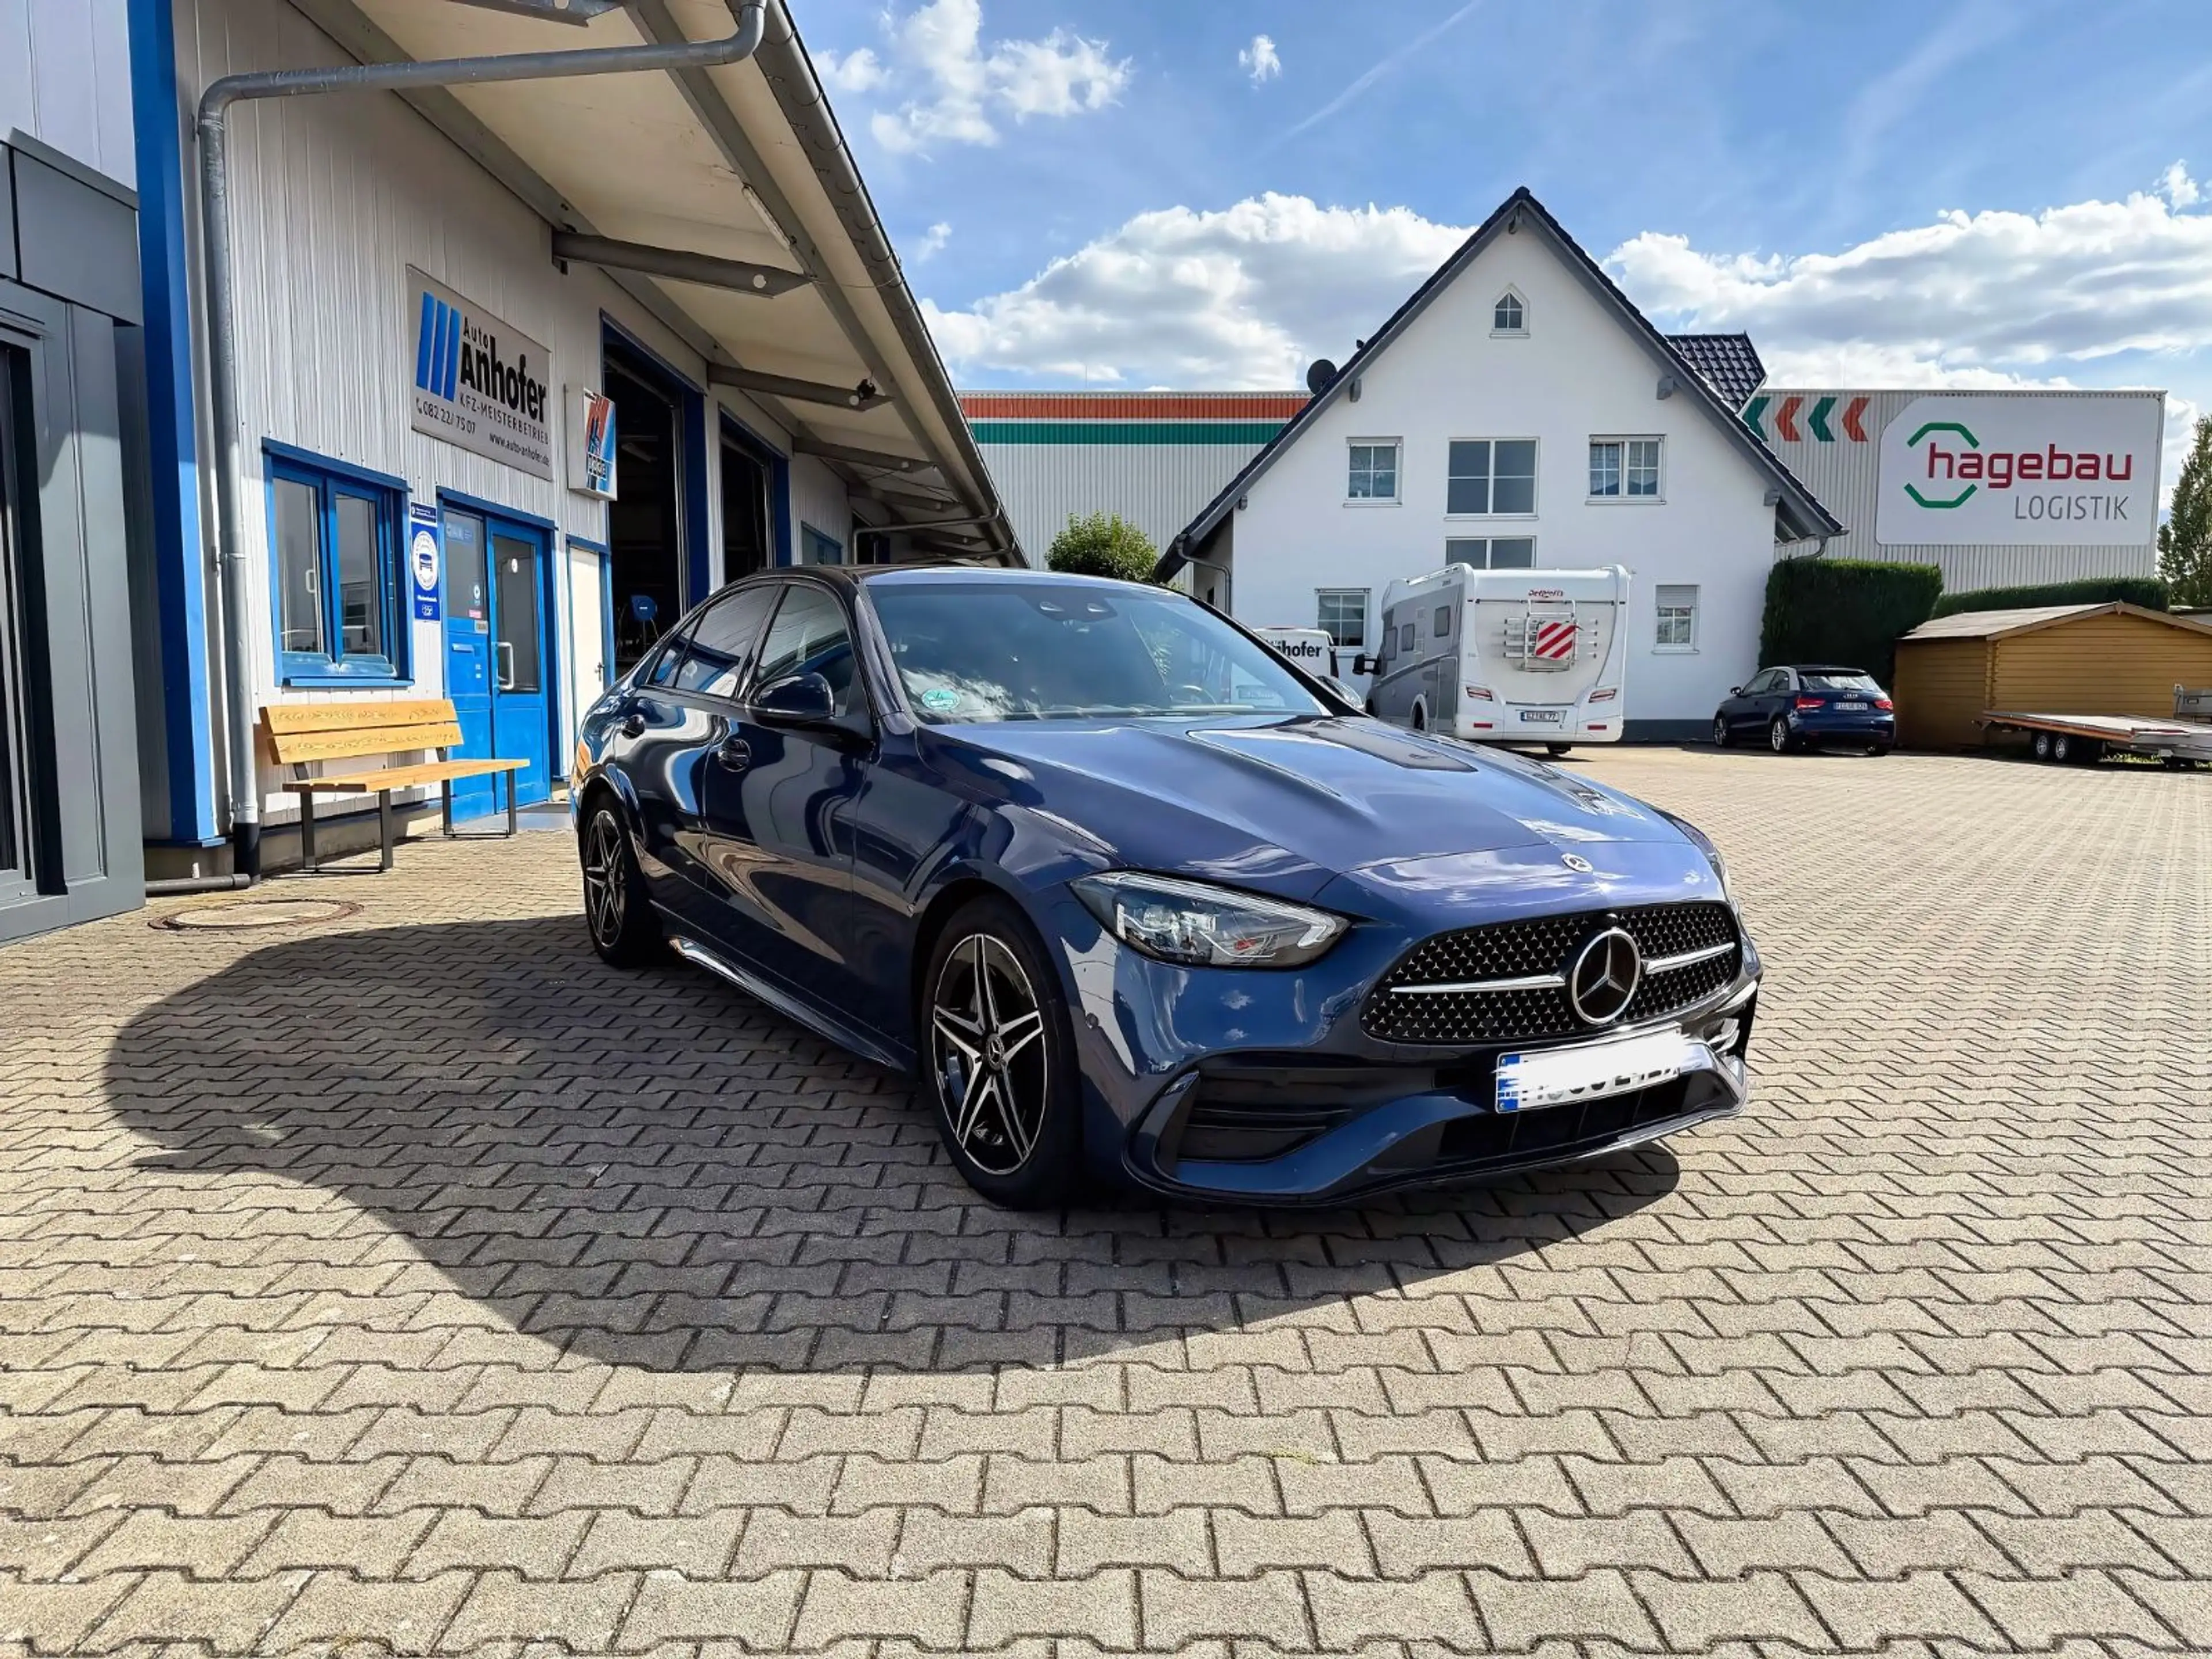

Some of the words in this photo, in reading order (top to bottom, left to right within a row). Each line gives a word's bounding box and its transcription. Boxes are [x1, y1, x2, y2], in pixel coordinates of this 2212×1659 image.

[463, 316, 488, 349] Auto
[460, 334, 546, 423] Anhofer
[460, 392, 549, 445] KFZ-MEISTERBETRIEB
[1927, 442, 2133, 488] hagebau
[2014, 495, 2129, 520] LOGISTIK
